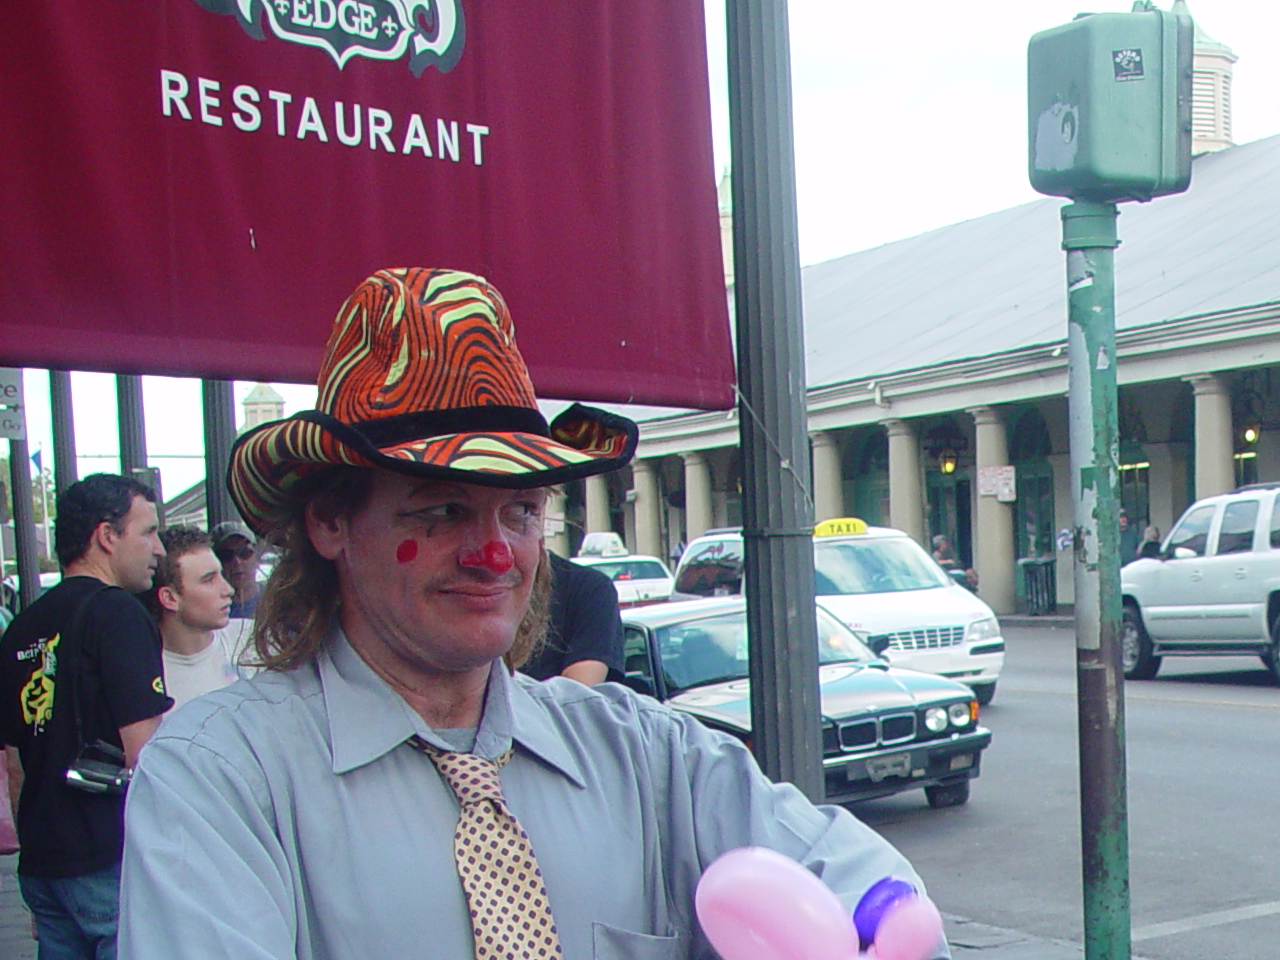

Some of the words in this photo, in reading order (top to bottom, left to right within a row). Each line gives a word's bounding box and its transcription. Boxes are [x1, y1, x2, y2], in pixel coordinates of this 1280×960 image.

[291, 0, 379, 40] EDGE
[160, 69, 489, 166] RESTAURANT
[829, 523, 857, 534] TAXI
